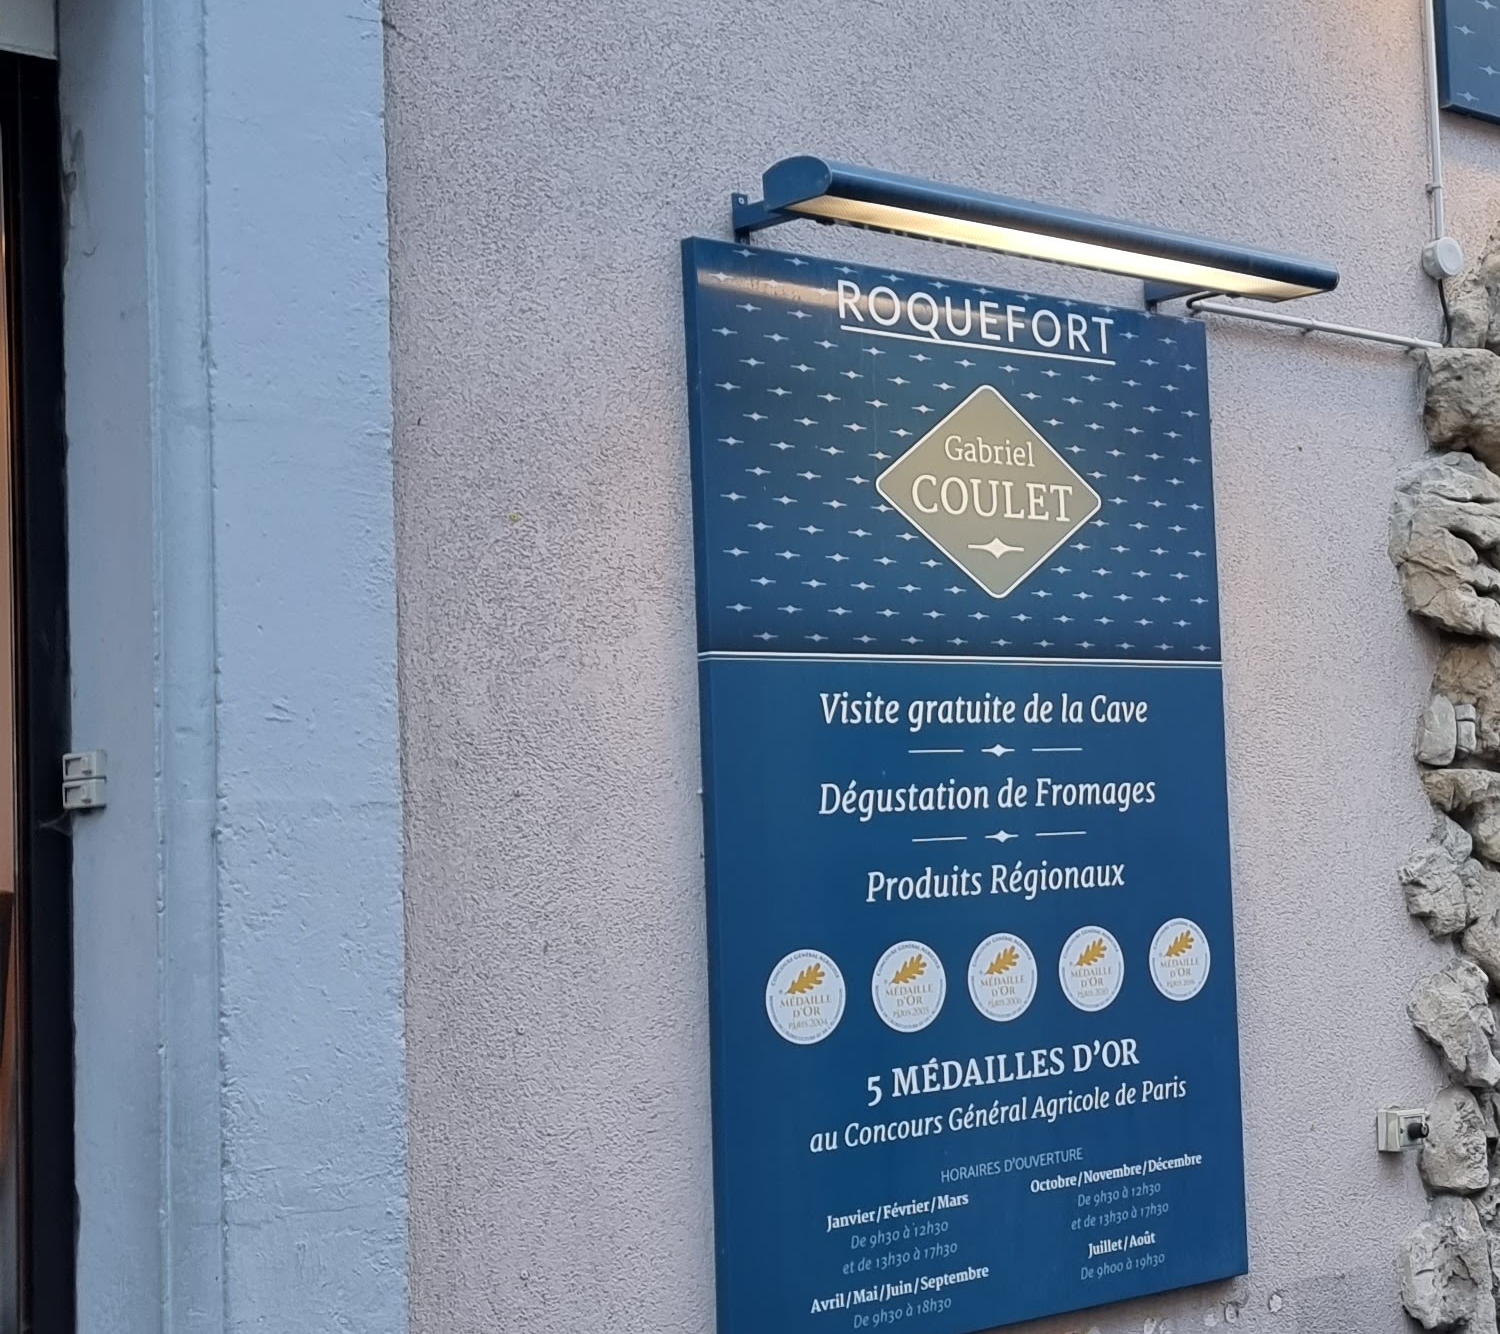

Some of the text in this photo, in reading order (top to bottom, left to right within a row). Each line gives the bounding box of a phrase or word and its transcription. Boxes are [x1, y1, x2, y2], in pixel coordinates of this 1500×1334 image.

[837, 279, 1115, 354] ROQUEFORT
[944, 435, 1036, 468] Gabriel
[911, 475, 1073, 523] COULET
[819, 691, 1148, 733] Visite gratuite de la Cave
[818, 777, 1156, 822] Dégustation de Fromages
[865, 860, 1125, 903] Produits Régionaux
[780, 994, 832, 1008] MÉDAILLE
[885, 984, 932, 997] MÉDAILLE
[867, 1037, 1139, 1107] 5 MÉDAILLES D'OR
[809, 1077, 1187, 1154] au Concours Général Agricole de Paris
[940, 1160, 1001, 1184] HORAIRES
[1077, 1182, 1161, 1207] De 9h30 à 12h30
[1071, 1202, 1169, 1230] et de 13h30 à 17h30
[851, 1221, 949, 1250] De 9h30 à 12h30
[1088, 1230, 1156, 1259] Juillet/Août
[842, 1242, 958, 1275] et de 13h30 à 17h30
[1080, 1253, 1165, 1281] De 9h00 à 19h30
[853, 1298, 952, 1329] De 9h30 à 18h30
